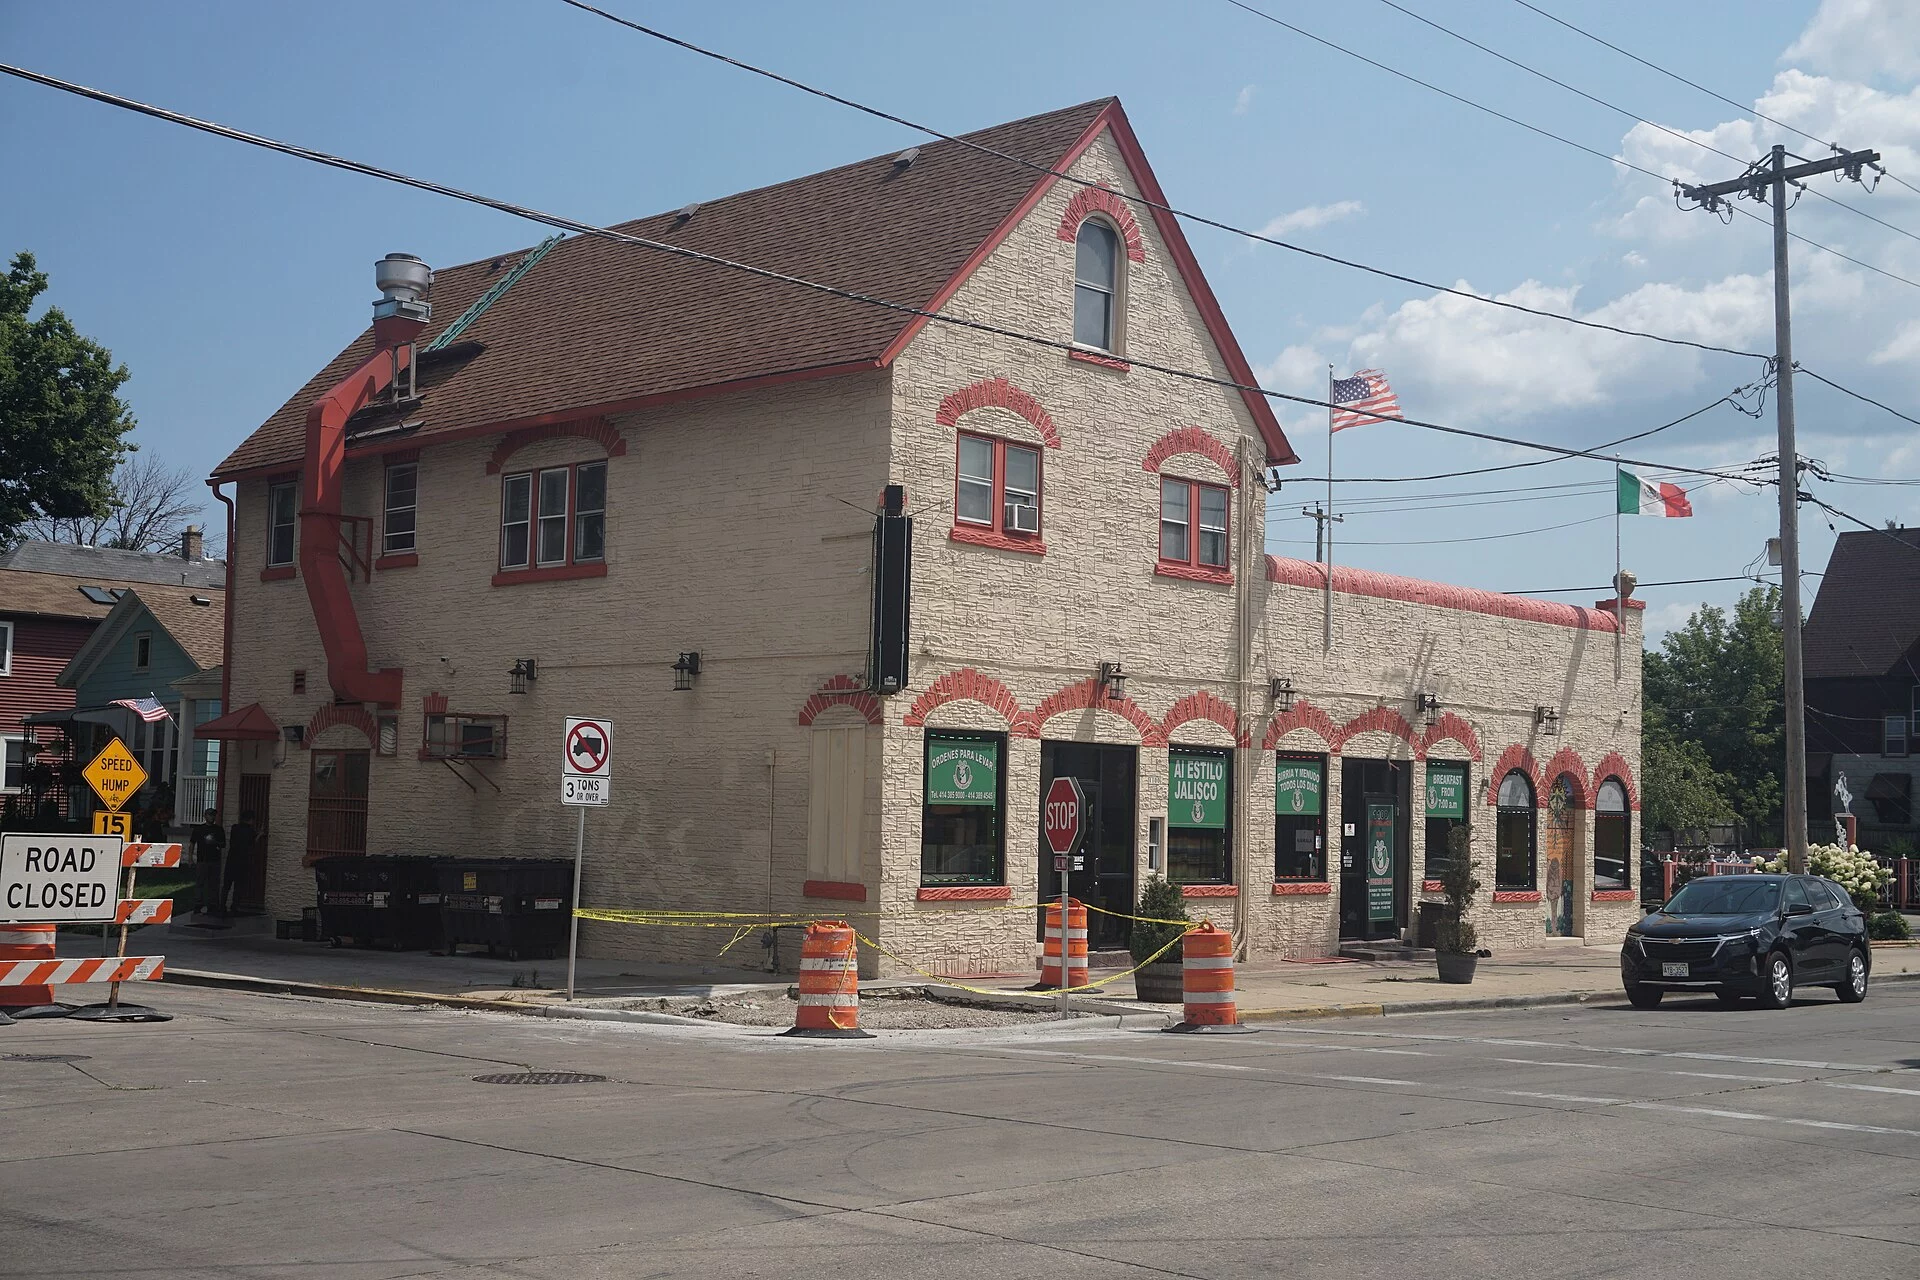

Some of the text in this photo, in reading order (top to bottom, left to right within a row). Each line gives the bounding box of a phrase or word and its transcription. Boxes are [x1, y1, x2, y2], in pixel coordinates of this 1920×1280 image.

[101, 757, 132, 771] SPEED
[931, 749, 994, 771] ORDENES PARA LEVAR
[1187, 760, 1223, 781] ESTILO
[1277, 768, 1320, 783] BIRRIA Y MENUDO
[102, 778, 130, 792] HUMP
[1280, 779, 1296, 793] TODOS
[1296, 779, 1306, 789] LOS
[1433, 774, 1463, 785] BREAKFAST
[566, 779, 600, 798] 3 TONS
[939, 791, 947, 799] 414
[1174, 780, 1218, 801] JALISCO
[1441, 787, 1455, 797] FROM
[576, 792, 584, 801] OR
[585, 792, 600, 802] OVER
[1438, 799, 1449, 809] 7:00
[1047, 801, 1076, 830] STOP
[102, 815, 125, 834] 15
[25, 847, 96, 873] ROAD
[7, 883, 106, 909] CLOSED
